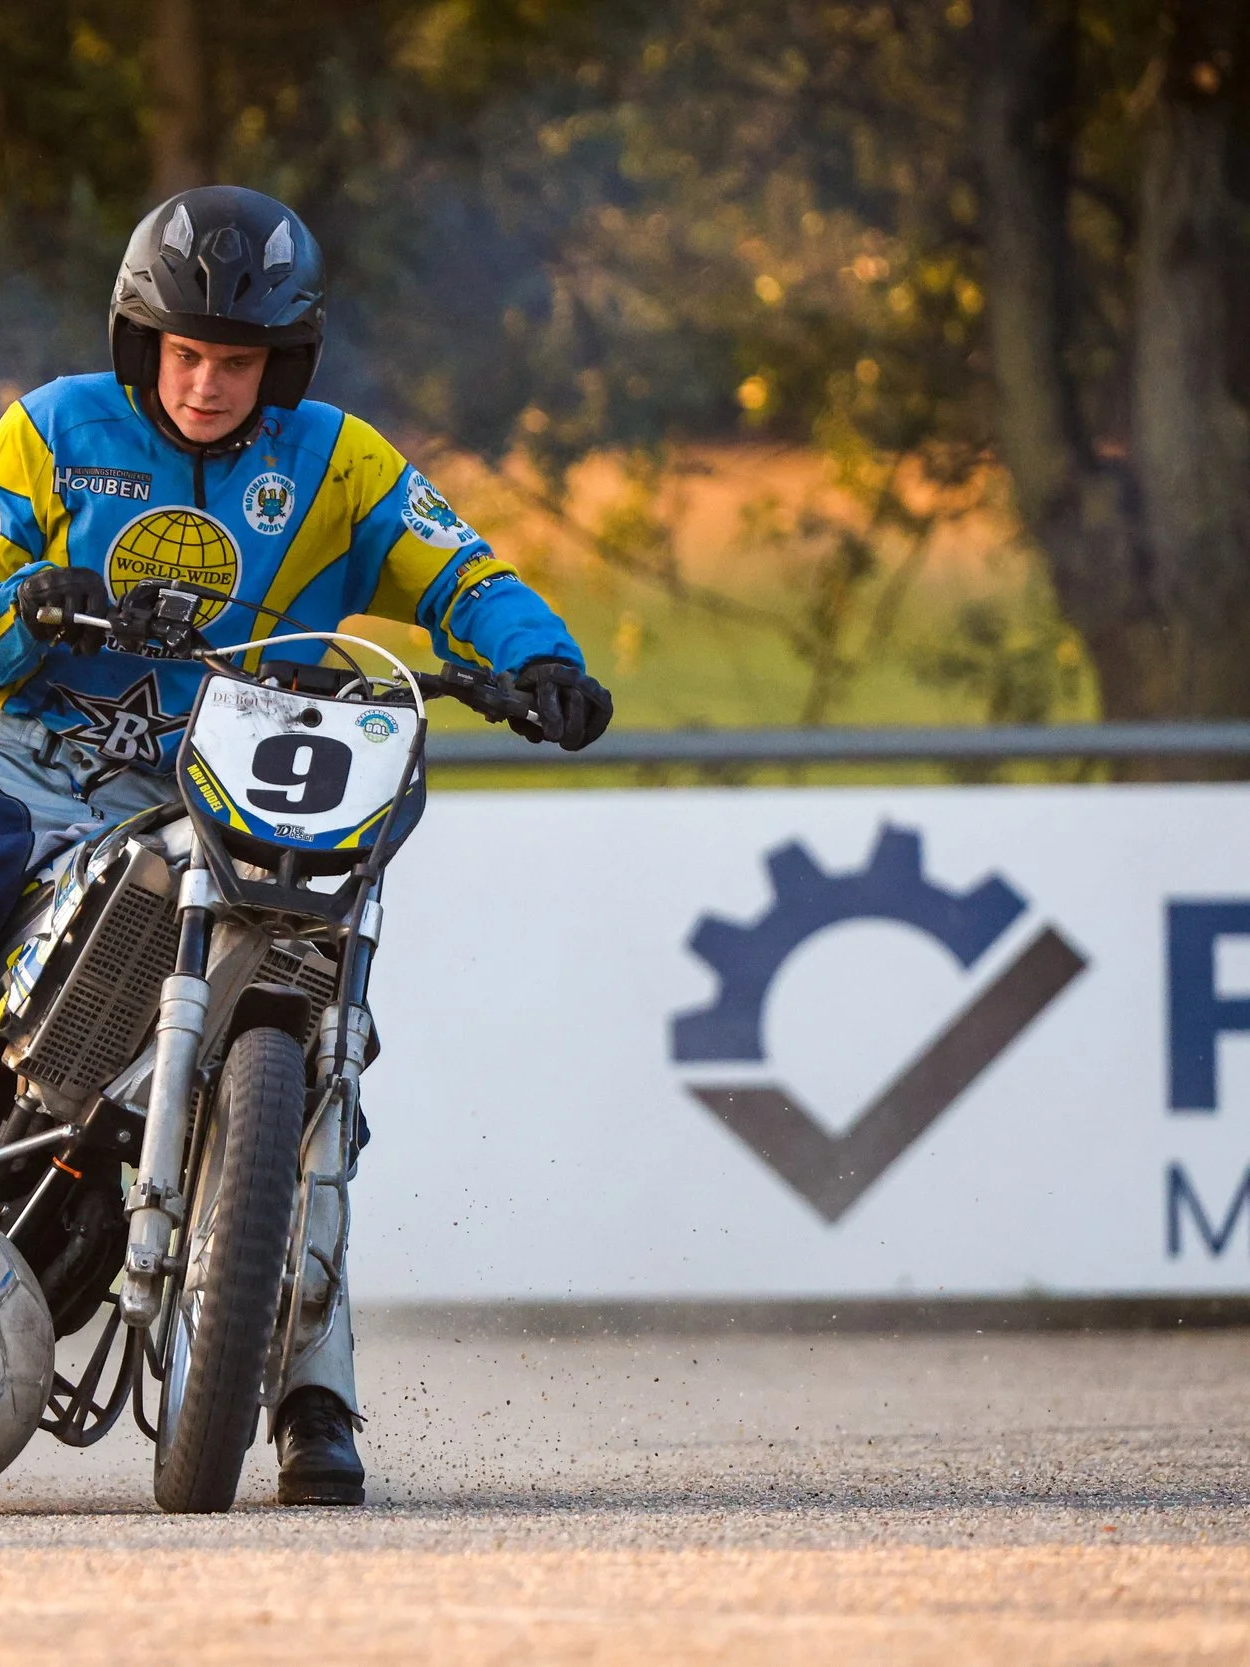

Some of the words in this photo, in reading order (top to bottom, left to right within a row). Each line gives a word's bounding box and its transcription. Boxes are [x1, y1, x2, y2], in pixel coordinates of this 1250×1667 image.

[54, 466, 150, 501] HOUBEN
[257, 522, 285, 533] BUDEL
[116, 556, 233, 586] WORLD-WIDE
[186, 764, 208, 786] MBV
[198, 781, 224, 814] BUDEL
[246, 733, 353, 815] 9
